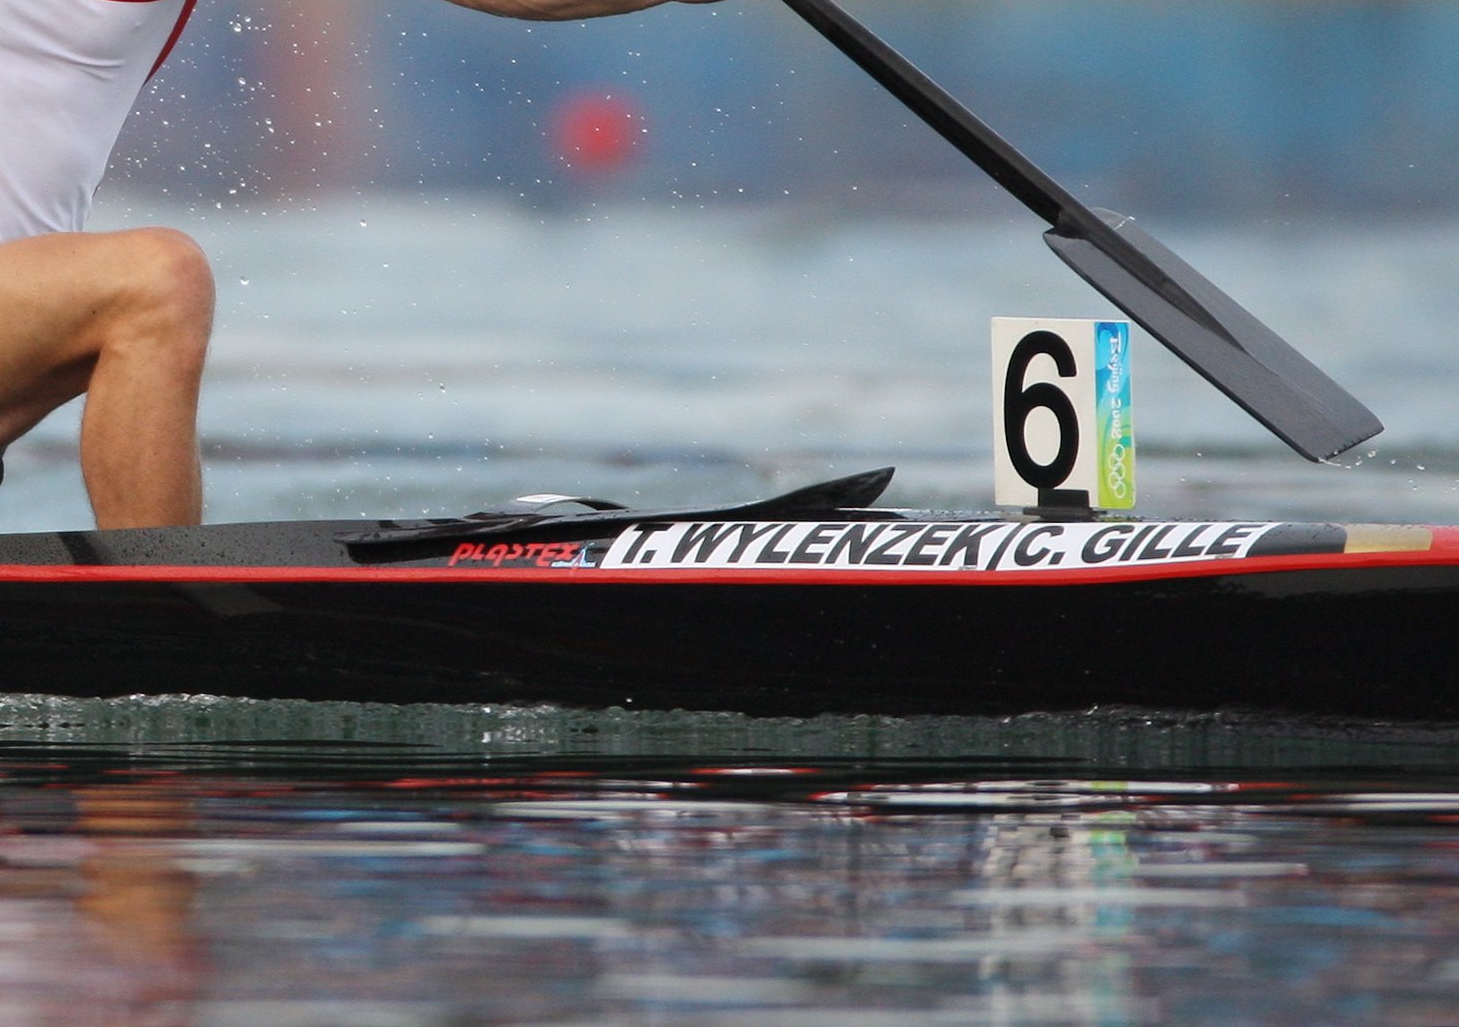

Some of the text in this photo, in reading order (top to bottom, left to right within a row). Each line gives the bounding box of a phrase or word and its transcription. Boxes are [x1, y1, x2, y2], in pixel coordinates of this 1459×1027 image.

[1003, 329, 1080, 489] 6
[621, 523, 675, 564] T.
[1081, 524, 1266, 564] GILLE
